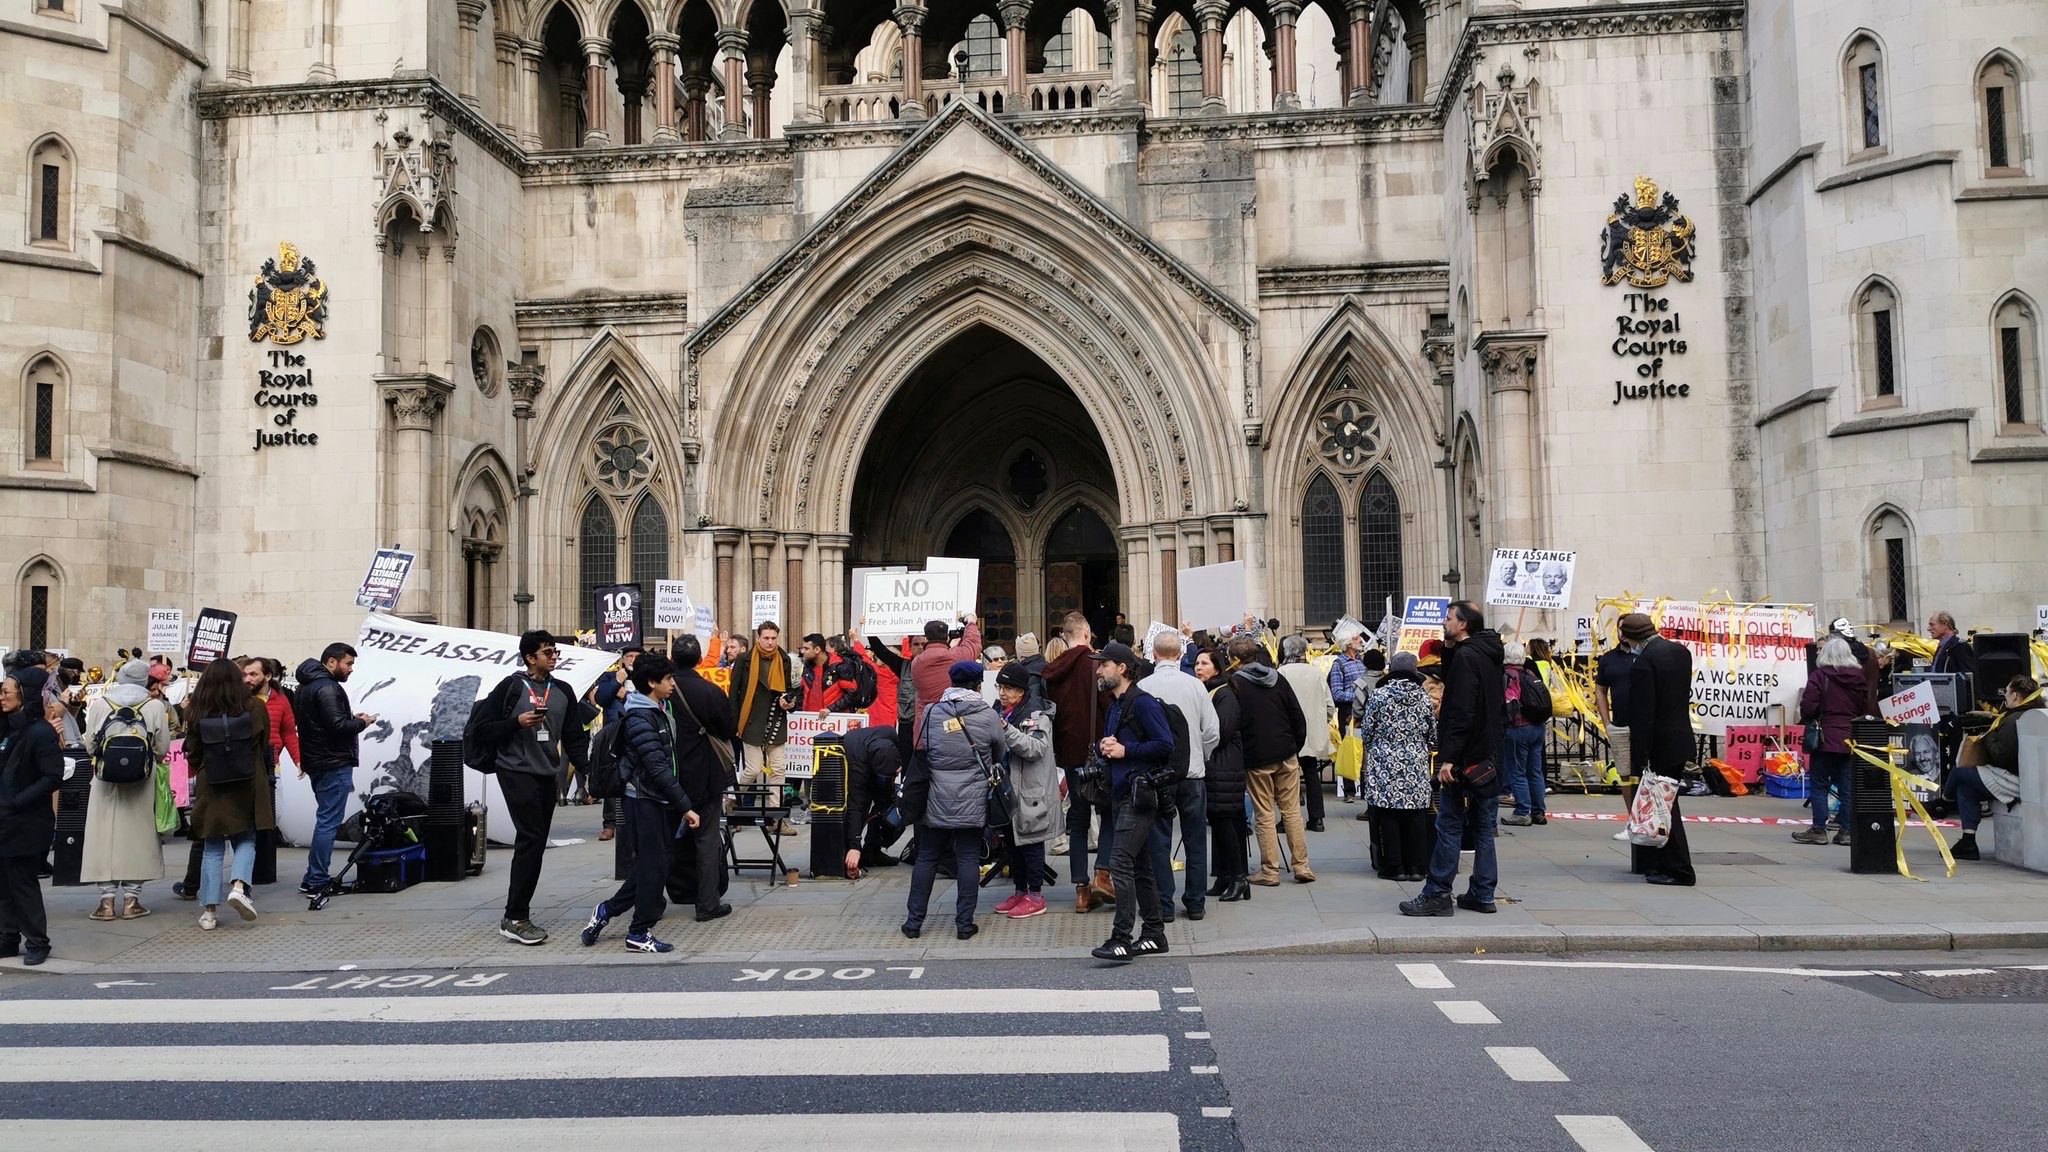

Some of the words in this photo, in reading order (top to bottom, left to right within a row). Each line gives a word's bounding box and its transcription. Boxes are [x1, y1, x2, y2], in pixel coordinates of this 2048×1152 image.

[1624, 293, 1670, 313] The
[1616, 313, 1680, 338] Royal
[1612, 338, 1687, 357] Courts
[268, 350, 306, 369] The
[1637, 358, 1664, 378] of
[259, 368, 312, 390] Royal
[254, 390, 318, 408] Courts
[1613, 380, 1690, 405] Justice
[274, 408, 296, 427] of
[253, 428, 318, 450] Justice
[374, 556, 410, 572] DON'T
[1496, 550, 1520, 560] FREE
[1522, 551, 1572, 562] ASSANGE
[660, 585, 684, 594] FREE
[894, 578, 930, 598] NO
[604, 592, 632, 612] 10
[869, 600, 954, 612] EXTRADITION
[1414, 601, 1440, 611] JAIL
[1669, 604, 1697, 612] Socialists
[152, 612, 180, 620] FREE
[604, 610, 633, 618] YEARS
[658, 615, 684, 624] NOW!
[890, 617, 914, 626] Julian
[916, 616, 952, 625] Asge
[199, 616, 231, 634] DON'T
[1578, 618, 1594, 629] RI
[1661, 616, 1704, 630] SBAND
[1708, 620, 1729, 633] THE
[1404, 628, 1440, 638] FREE
[1679, 628, 1719, 643] JULIN
[1722, 634, 1779, 646] ASANGE
[195, 638, 226, 652] ASSANGE
[361, 628, 428, 654] FREE
[421, 641, 584, 672] ASSANE
[1695, 643, 1716, 657] THE
[1722, 644, 1768, 660] TOIES
[1774, 646, 1807, 661] OUT!
[1696, 671, 1705, 683] A
[1710, 671, 1779, 687] WORKERS
[1688, 688, 1770, 704] VERNMENT
[1891, 692, 1916, 707] Free
[788, 718, 840, 732] olitical
[1739, 748, 1752, 760] is
[269, 973, 509, 990] RIGHT
[732, 967, 925, 982] LOOK
